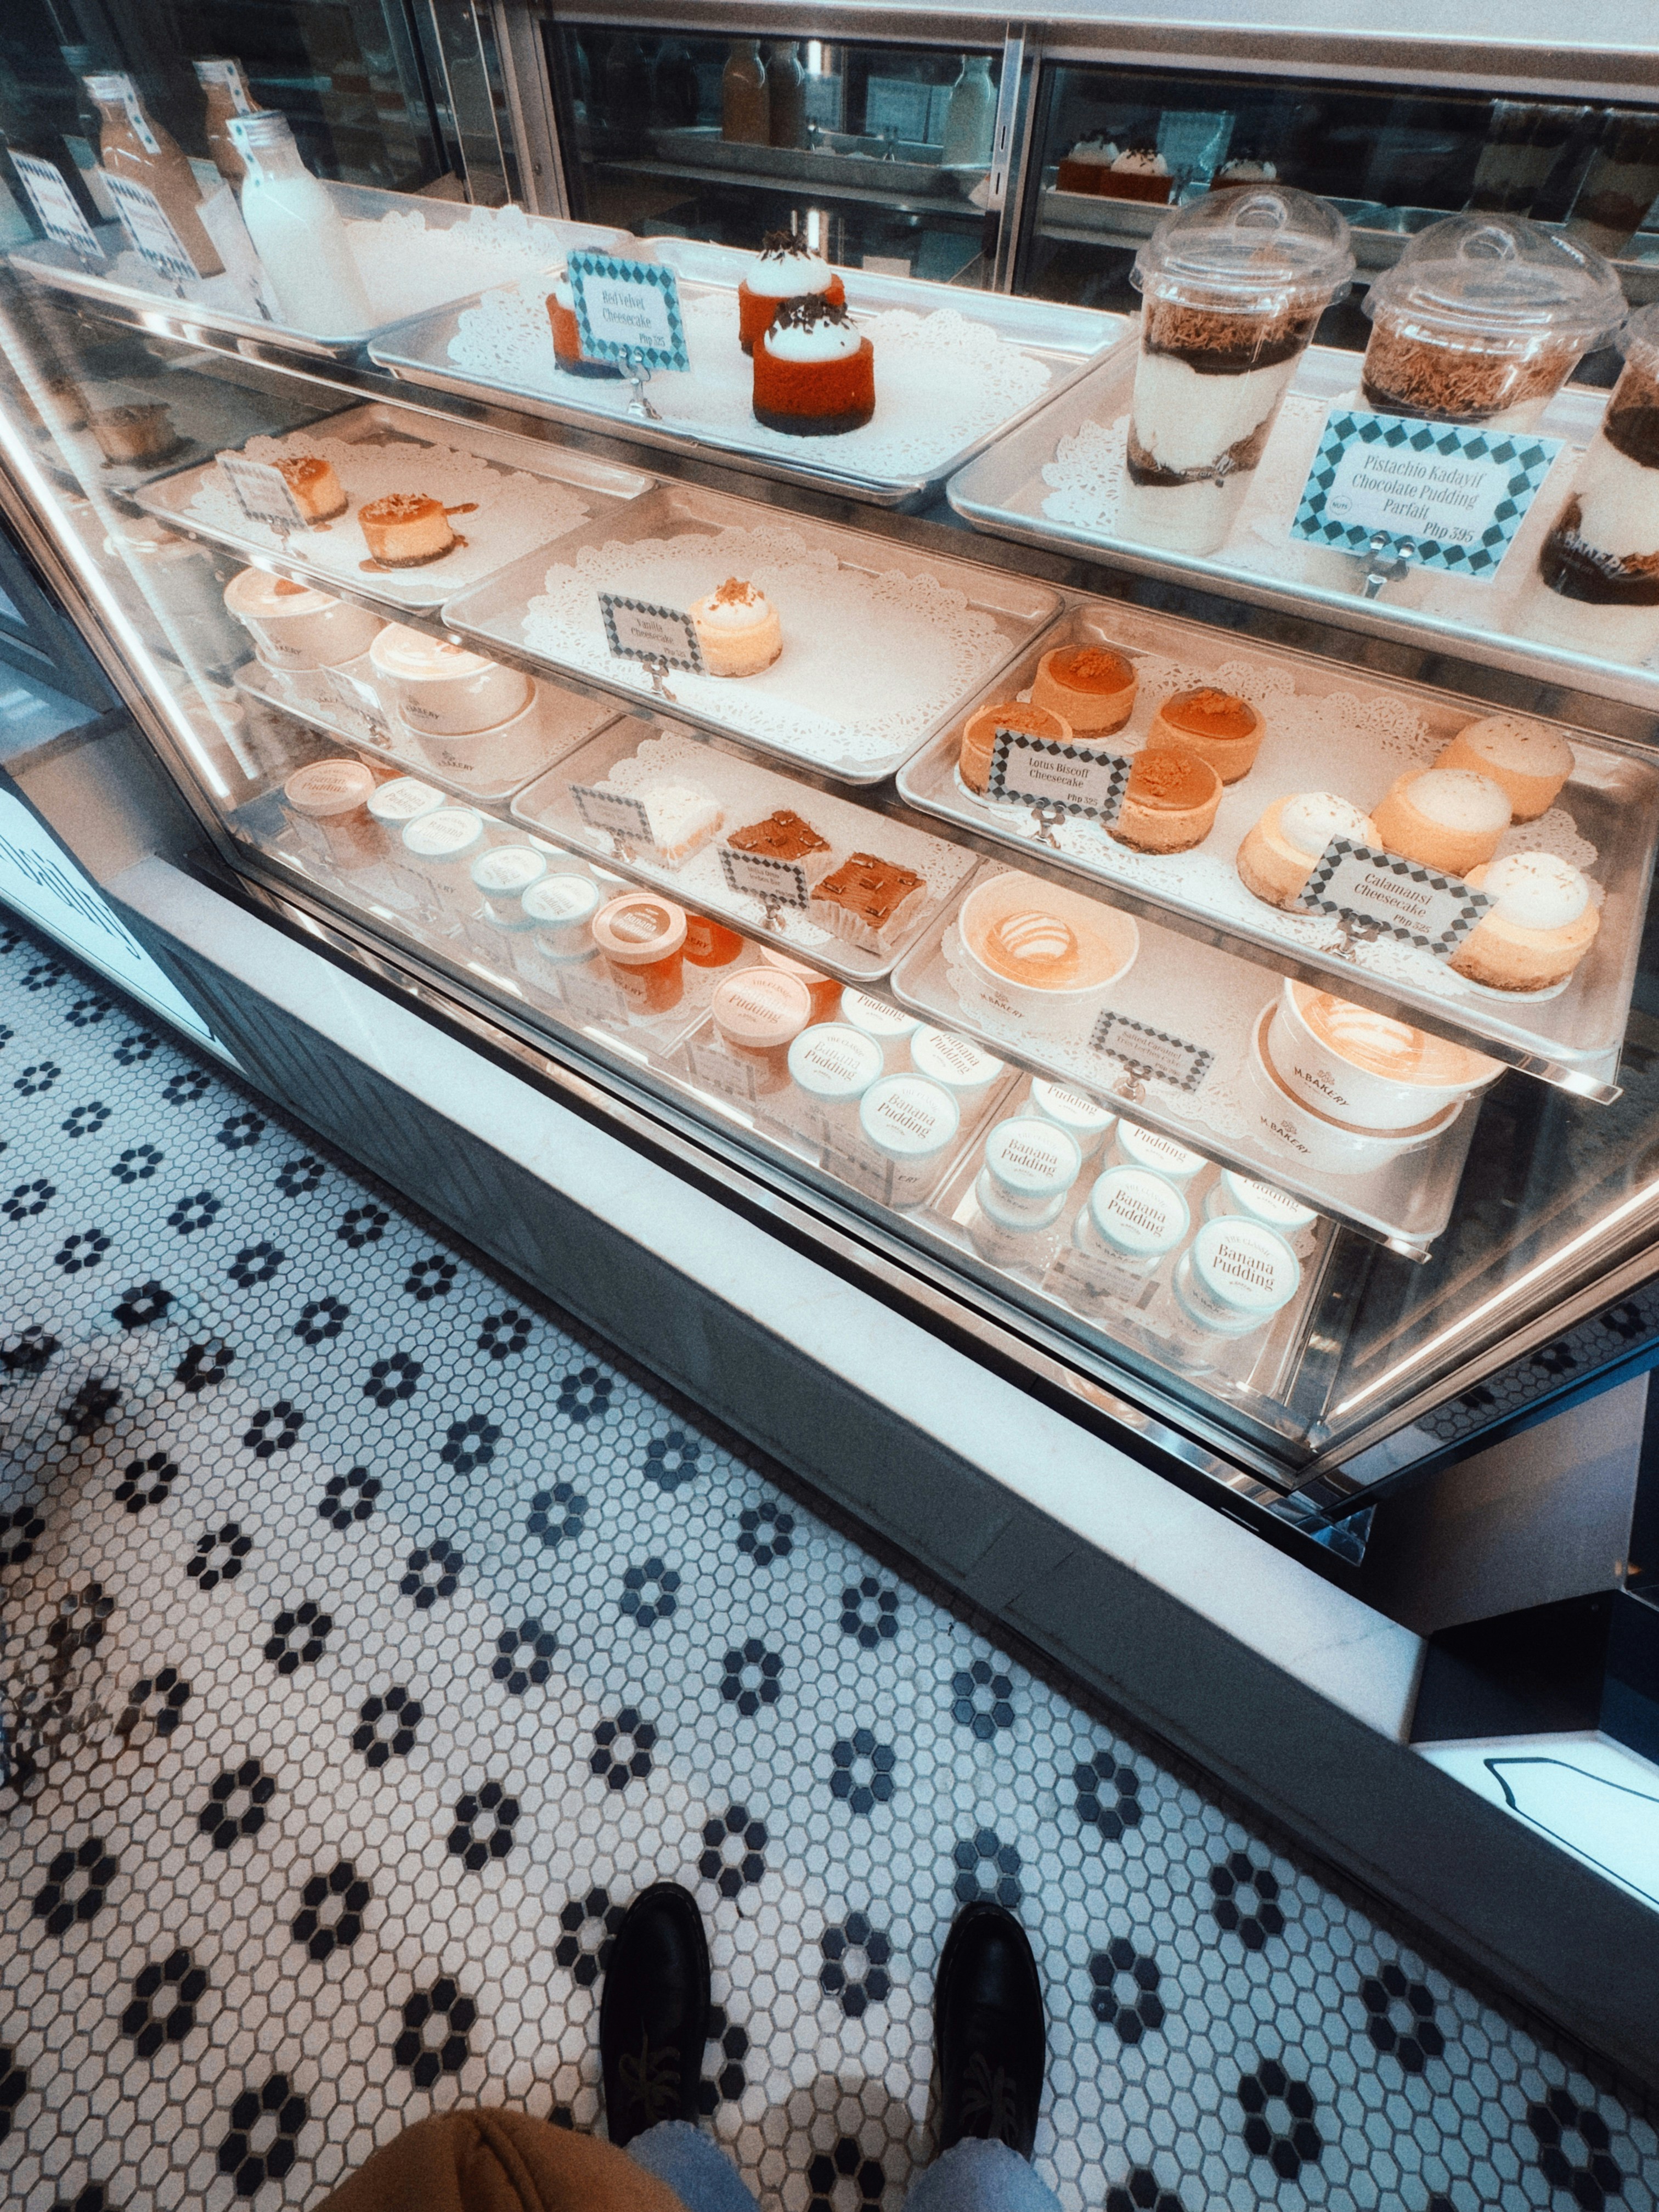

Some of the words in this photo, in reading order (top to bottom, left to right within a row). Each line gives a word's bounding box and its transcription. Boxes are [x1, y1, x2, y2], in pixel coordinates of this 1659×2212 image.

[602, 290, 618, 306] Red
[618, 293, 646, 311] Velvet
[602, 307, 652, 329] Cheesecake
[639, 333, 653, 347] Php
[1363, 454, 1427, 479] Pistachio
[1427, 465, 1487, 489] Kadayif
[1351, 472, 1418, 500] Chocolate
[1418, 484, 1480, 511] Pudding
[1382, 498, 1431, 520] Parfait
[1422, 521, 1449, 540] Php
[1448, 526, 1475, 543] 395
[631, 627, 674, 645] Cheesecake
[636, 618, 663, 633] Vanilla
[1029, 757, 1054, 770] Lotus
[1056, 763, 1091, 778] Biscoff
[1029, 769, 1084, 788] Cheesecake
[1066, 793, 1083, 804] Php
[1083, 797, 1098, 806] 325
[1353, 883, 1427, 918] Cheesecake
[1364, 873, 1434, 906] Calamansi
[623, 912, 657, 932] Banana
[1392, 913, 1412, 927] Php
[1412, 922, 1432, 934] 325
[729, 994, 782, 1024] Pudding
[857, 995, 906, 1022] Pudding
[814, 1041, 861, 1070] Banana
[930, 1035, 972, 1075] Pudding
[1121, 1031, 1148, 1046] Salted
[1148, 1041, 1182, 1059] Caramel
[804, 1049, 857, 1082] Pudding
[1047, 1085, 1098, 1116] Pudding
[1294, 1065, 1350, 1107] M.BAKERY
[877, 1102, 932, 1139] Pudding
[888, 1093, 936, 1126] Banana
[1133, 1127, 1188, 1163] Pudding
[1260, 1115, 1311, 1155] M.BAKERY
[1001, 1148, 1057, 1178] Pudding
[1008, 1138, 1058, 1165] Banana
[1107, 1199, 1165, 1238] Pudding
[1115, 1189, 1166, 1223] Banana
[1212, 1256, 1275, 1293] Pudding
[1218, 1243, 1274, 1276] Banana
